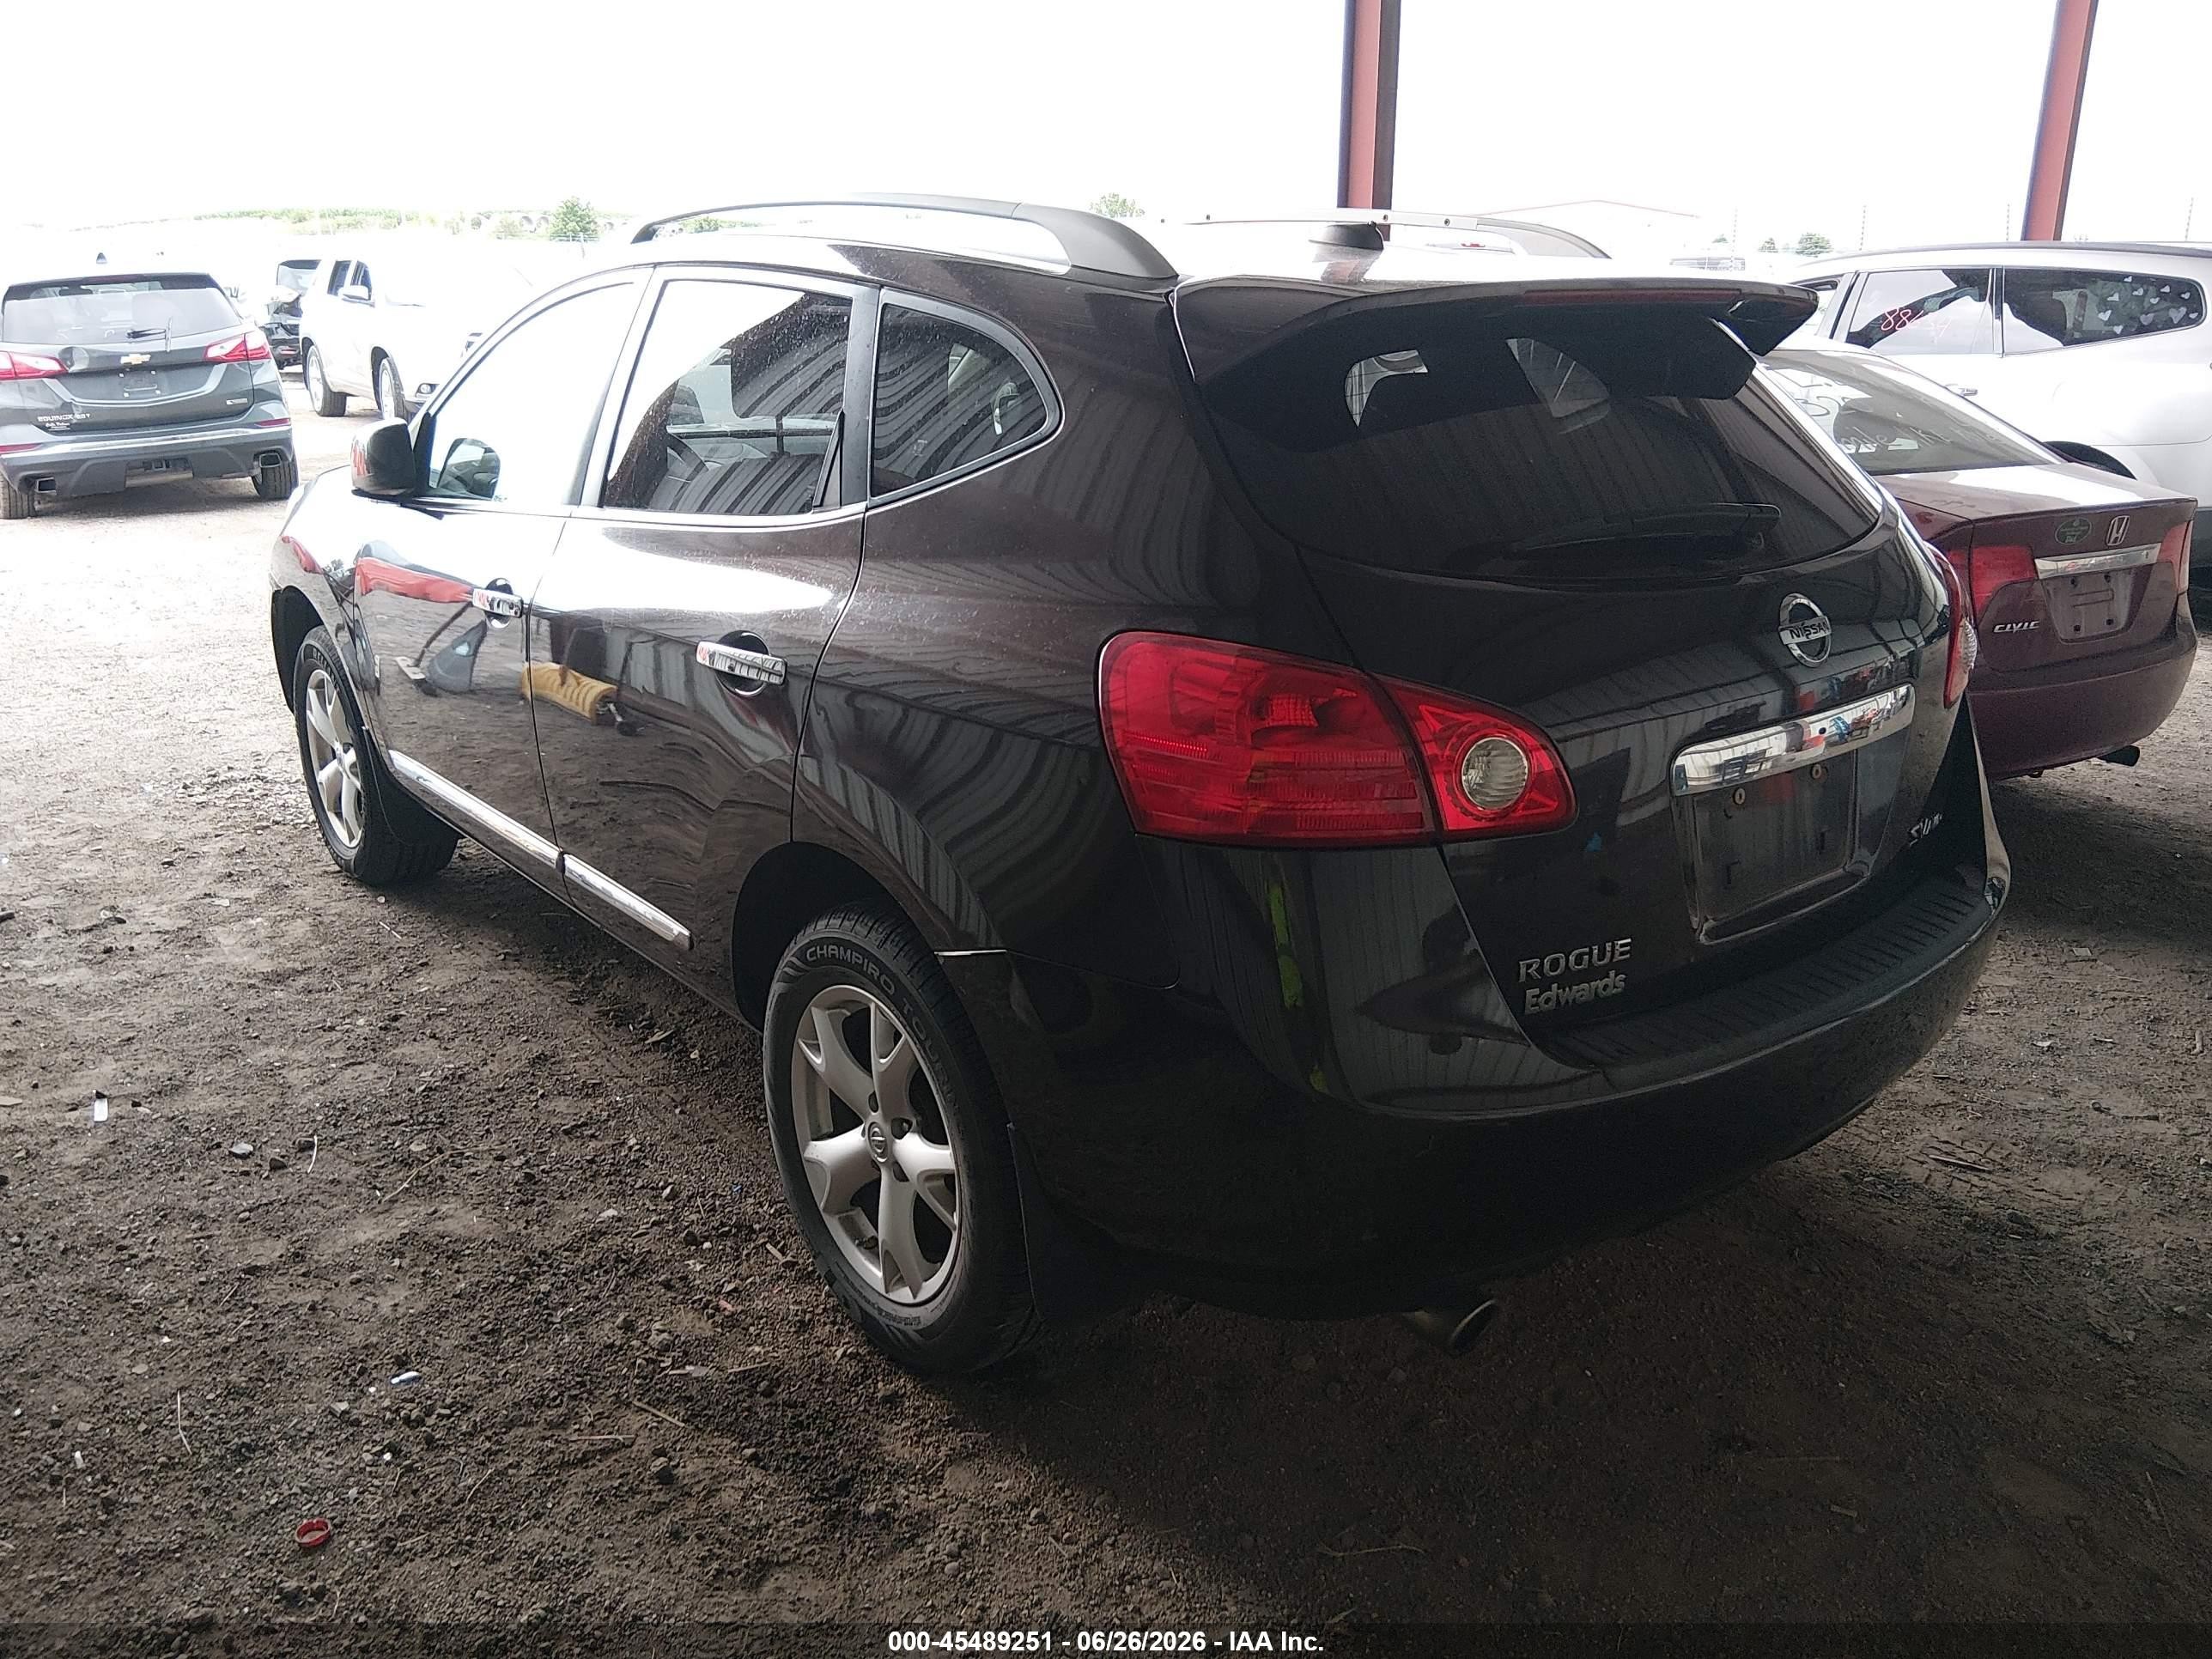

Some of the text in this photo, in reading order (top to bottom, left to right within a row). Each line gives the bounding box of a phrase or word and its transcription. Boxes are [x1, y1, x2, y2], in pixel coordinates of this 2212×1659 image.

[1789, 620, 1830, 640] NISSAN
[1993, 621, 2040, 634] CIVIC
[805, 945, 896, 996] CHAMPIRO
[1518, 938, 1632, 982] ROGUE
[1524, 969, 1626, 1014] Edwards
